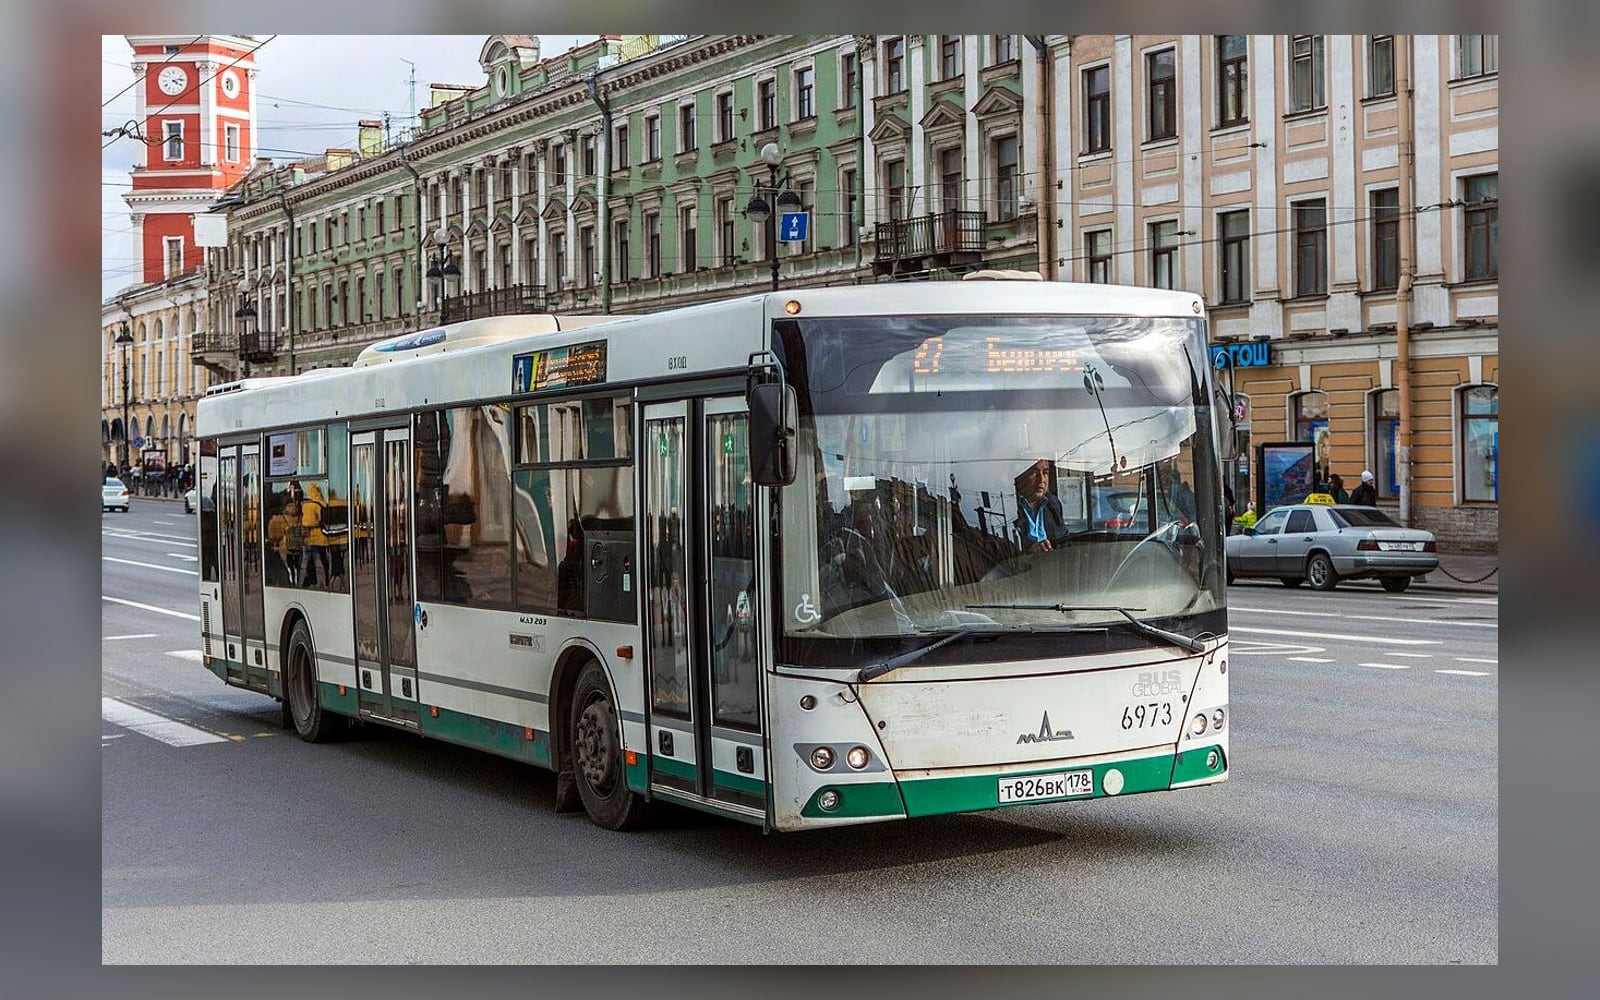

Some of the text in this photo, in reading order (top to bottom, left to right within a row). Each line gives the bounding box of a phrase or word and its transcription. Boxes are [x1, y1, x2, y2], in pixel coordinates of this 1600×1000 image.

[1228, 342, 1268, 367] ГОШ
[534, 618, 547, 626] 203
[1138, 669, 1182, 687] BUS
[1132, 680, 1186, 697] GLOBAL
[1121, 702, 1172, 730] 6973
[1066, 773, 1088, 788] 178
